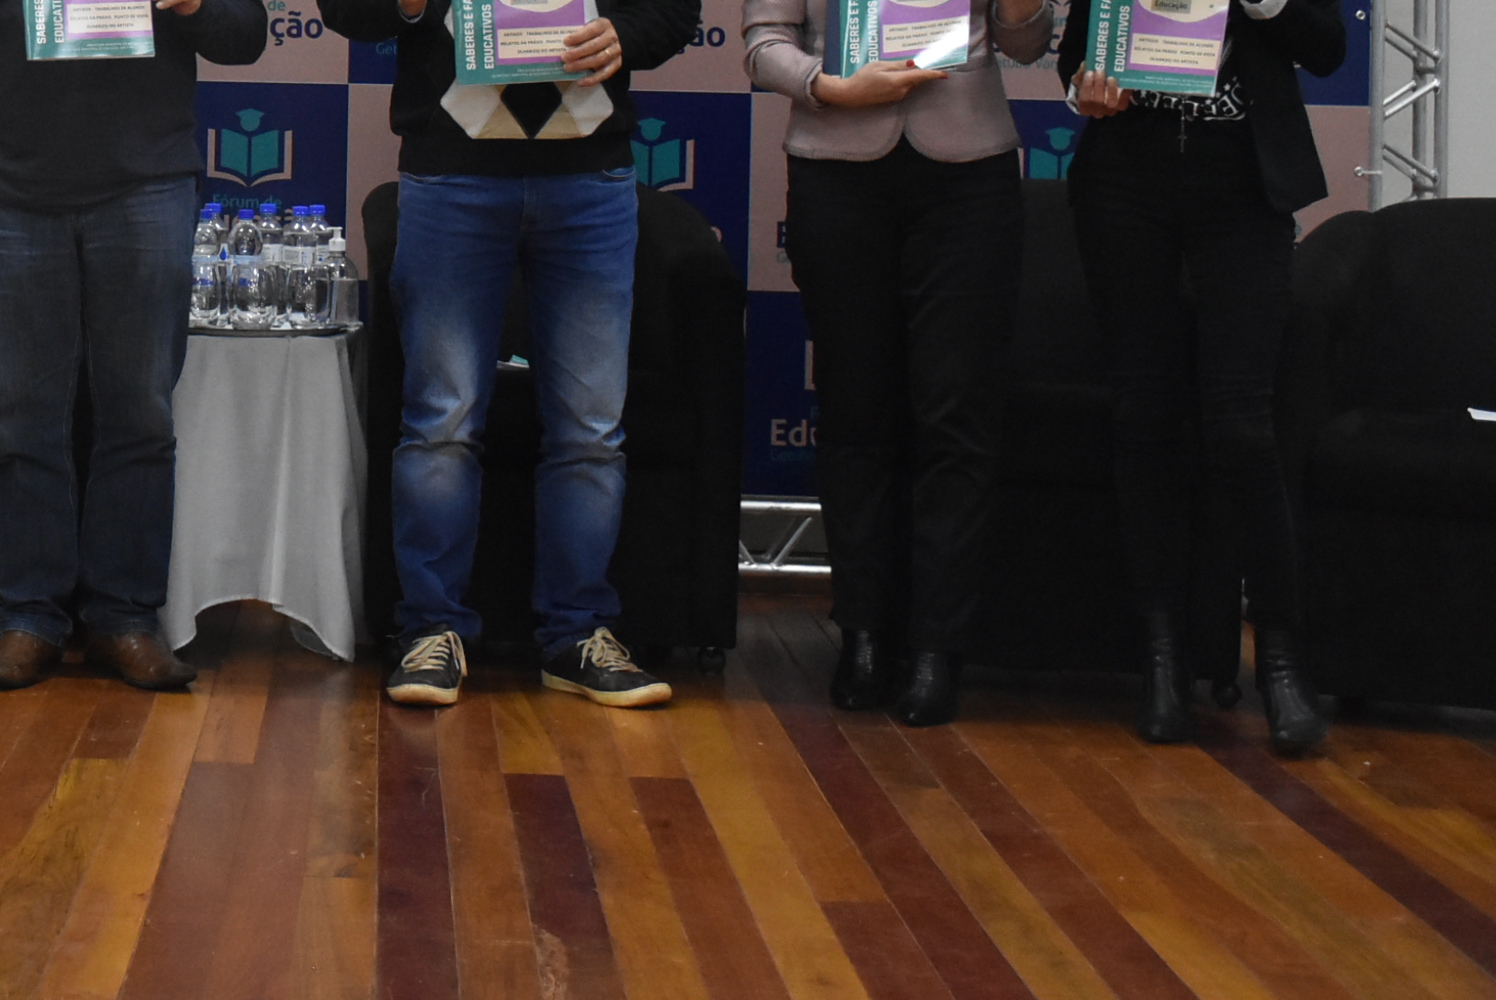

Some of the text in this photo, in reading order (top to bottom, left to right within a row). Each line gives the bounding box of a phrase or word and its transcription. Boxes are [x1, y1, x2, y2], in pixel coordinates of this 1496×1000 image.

[464, 12, 472, 20] E
[482, 4, 494, 70] EDUCATIVOS
[849, 17, 860, 64] SABERES
[867, 0, 878, 63] EDUCATIVOS
[1114, 5, 1130, 72] EDUCATIVOS
[464, 22, 476, 70] SABERES
[1095, 22, 1110, 72] SABERES
